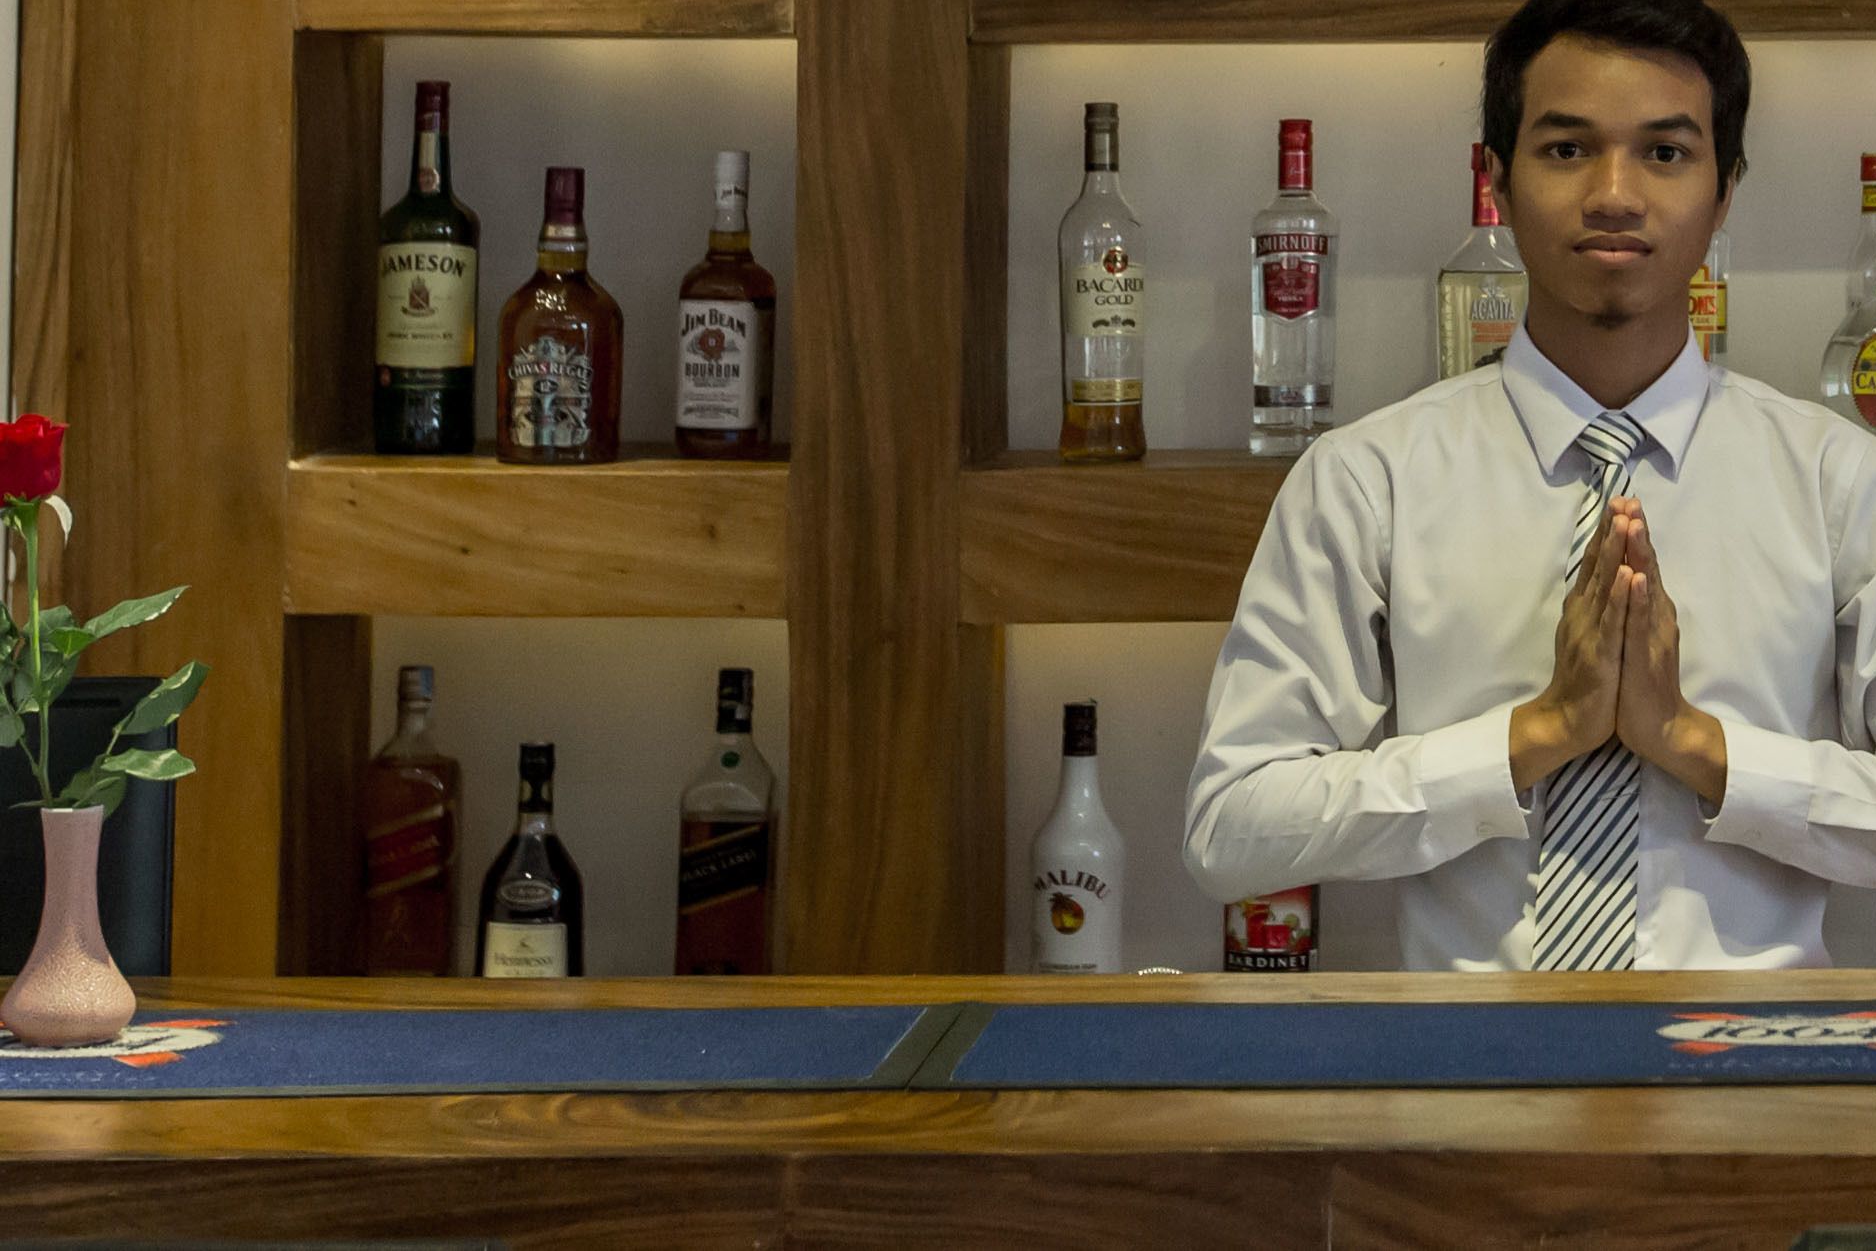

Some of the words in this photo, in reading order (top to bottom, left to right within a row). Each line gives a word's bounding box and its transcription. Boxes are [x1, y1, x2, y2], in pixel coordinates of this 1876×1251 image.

[1257, 235, 1327, 252] SMIRNOFF
[383, 252, 467, 280] JAMESON
[1094, 294, 1135, 306] GOLD
[681, 314, 707, 337] JIM
[708, 307, 747, 339] BEAM
[685, 362, 740, 378] BOURBON
[1034, 869, 1110, 903] MALIBU
